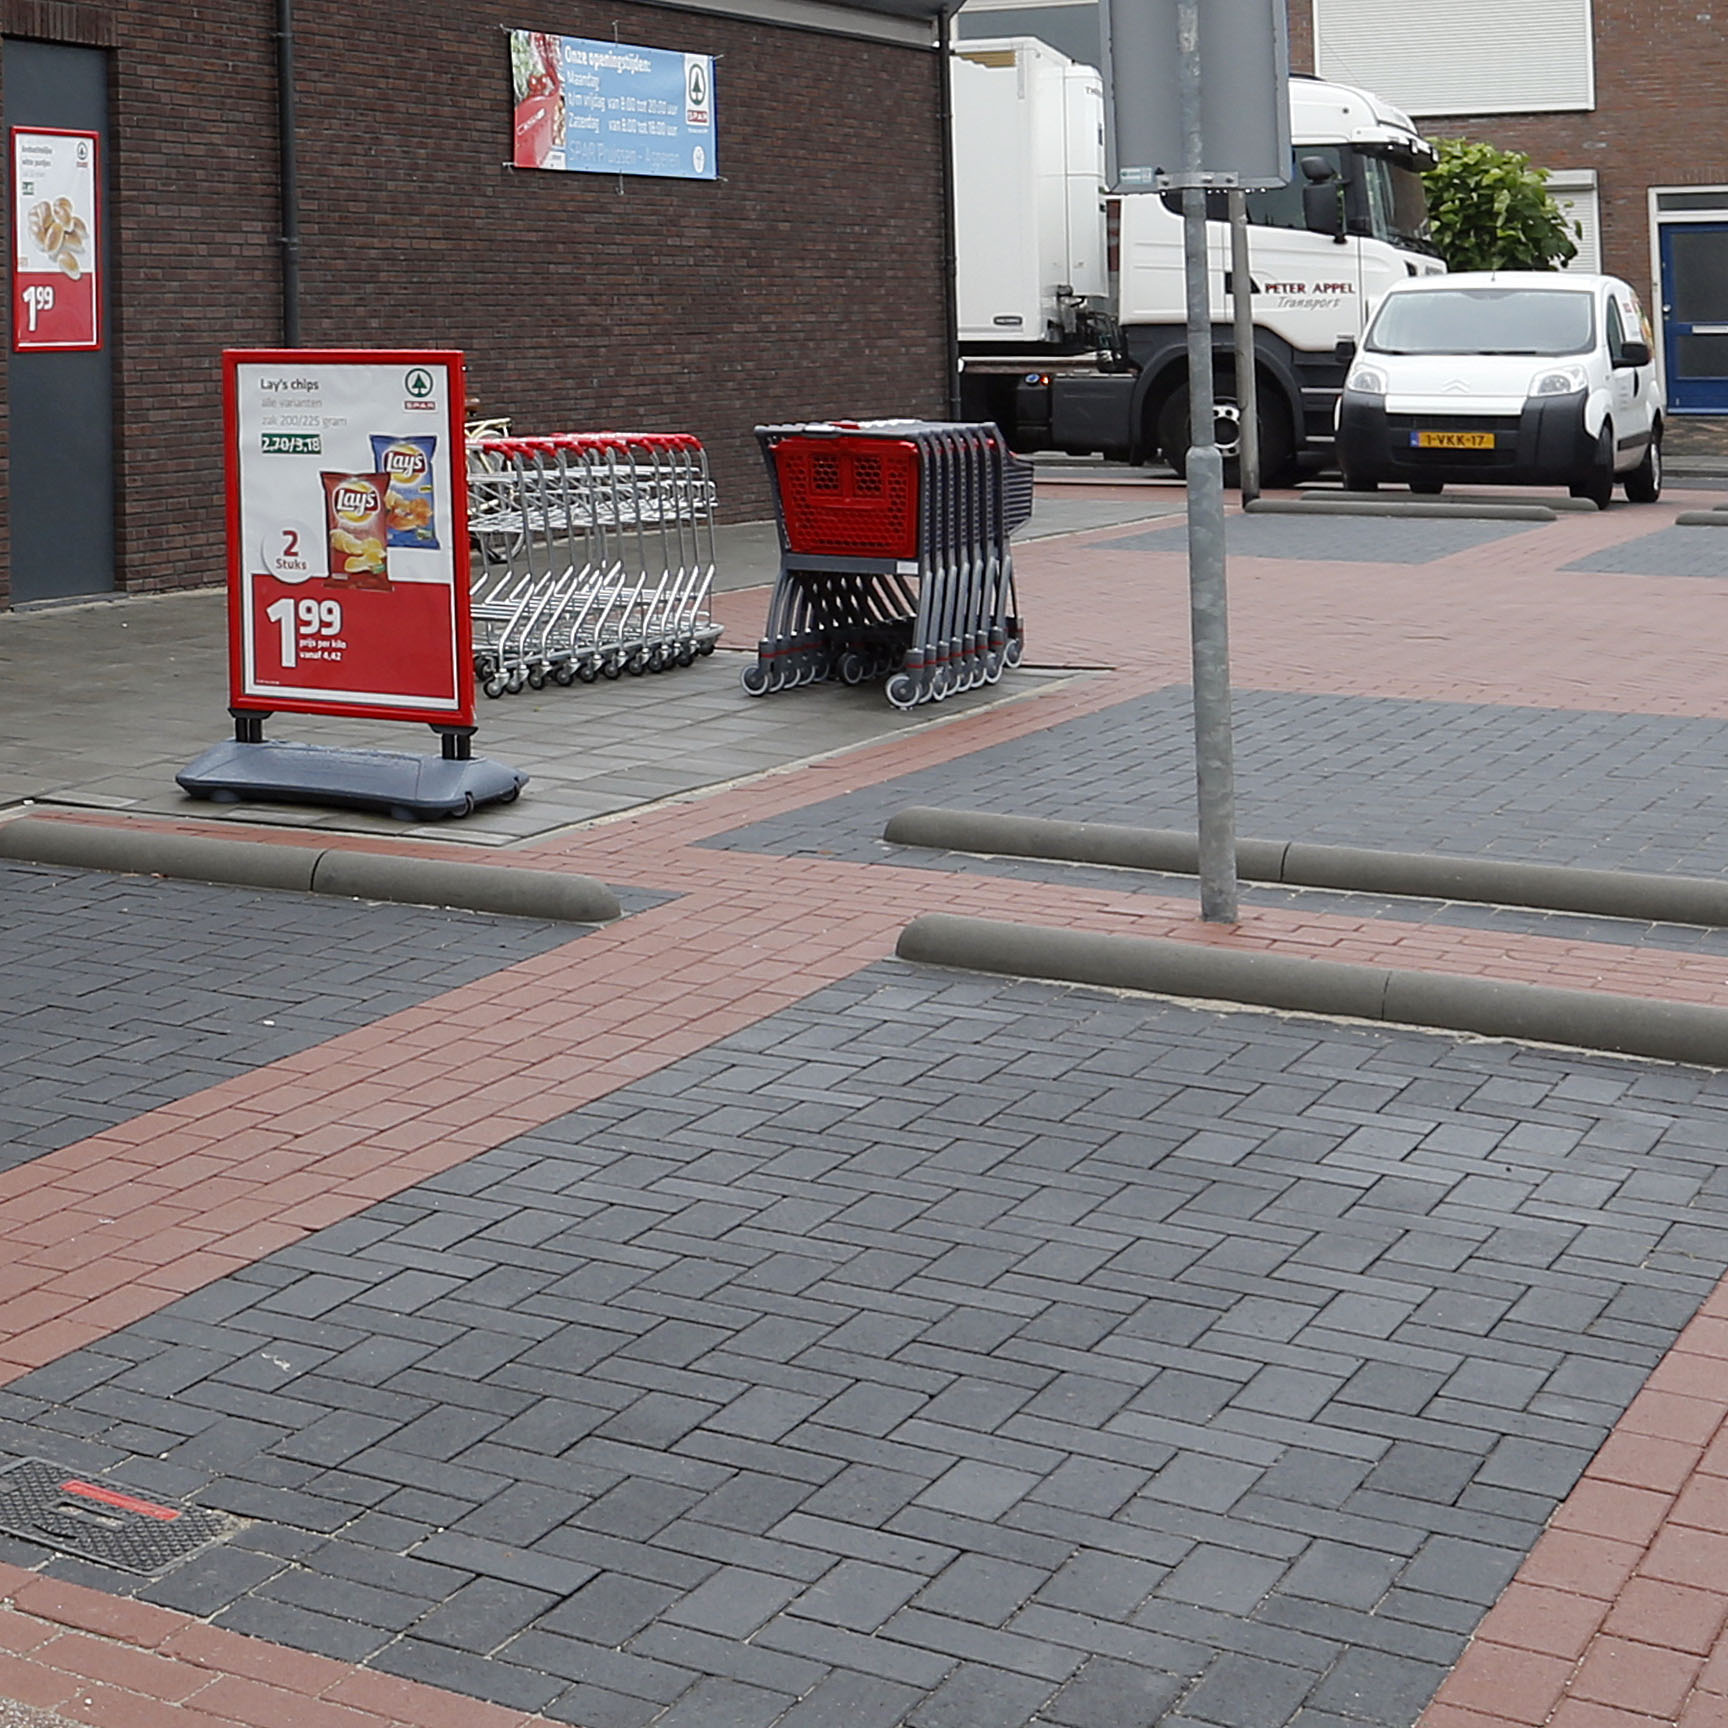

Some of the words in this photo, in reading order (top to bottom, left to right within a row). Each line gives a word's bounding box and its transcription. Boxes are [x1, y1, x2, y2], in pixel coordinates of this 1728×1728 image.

[565, 46, 588, 65] Onze
[567, 70, 600, 91] Maandag
[608, 98, 619, 109] van
[687, 111, 708, 121] SPAR
[609, 120, 621, 131] van
[1265, 283, 1306, 294] PETER
[1312, 283, 1355, 294] APPEL
[1277, 296, 1341, 311] Transport
[260, 379, 288, 392] Lay's
[291, 379, 319, 392] chips
[261, 398, 276, 408] alle
[279, 399, 322, 408] varianten
[262, 416, 276, 425] zak
[280, 415, 320, 426] 200/225
[322, 417, 347, 428] gram
[1426, 434, 1485, 447] 1-VKK-17
[282, 530, 299, 557] 2
[275, 558, 307, 570] Stuks
[299, 639, 316, 649] prijs
[317, 640, 331, 649] per
[331, 639, 347, 649] kilo
[299, 650, 321, 659] vanaf
